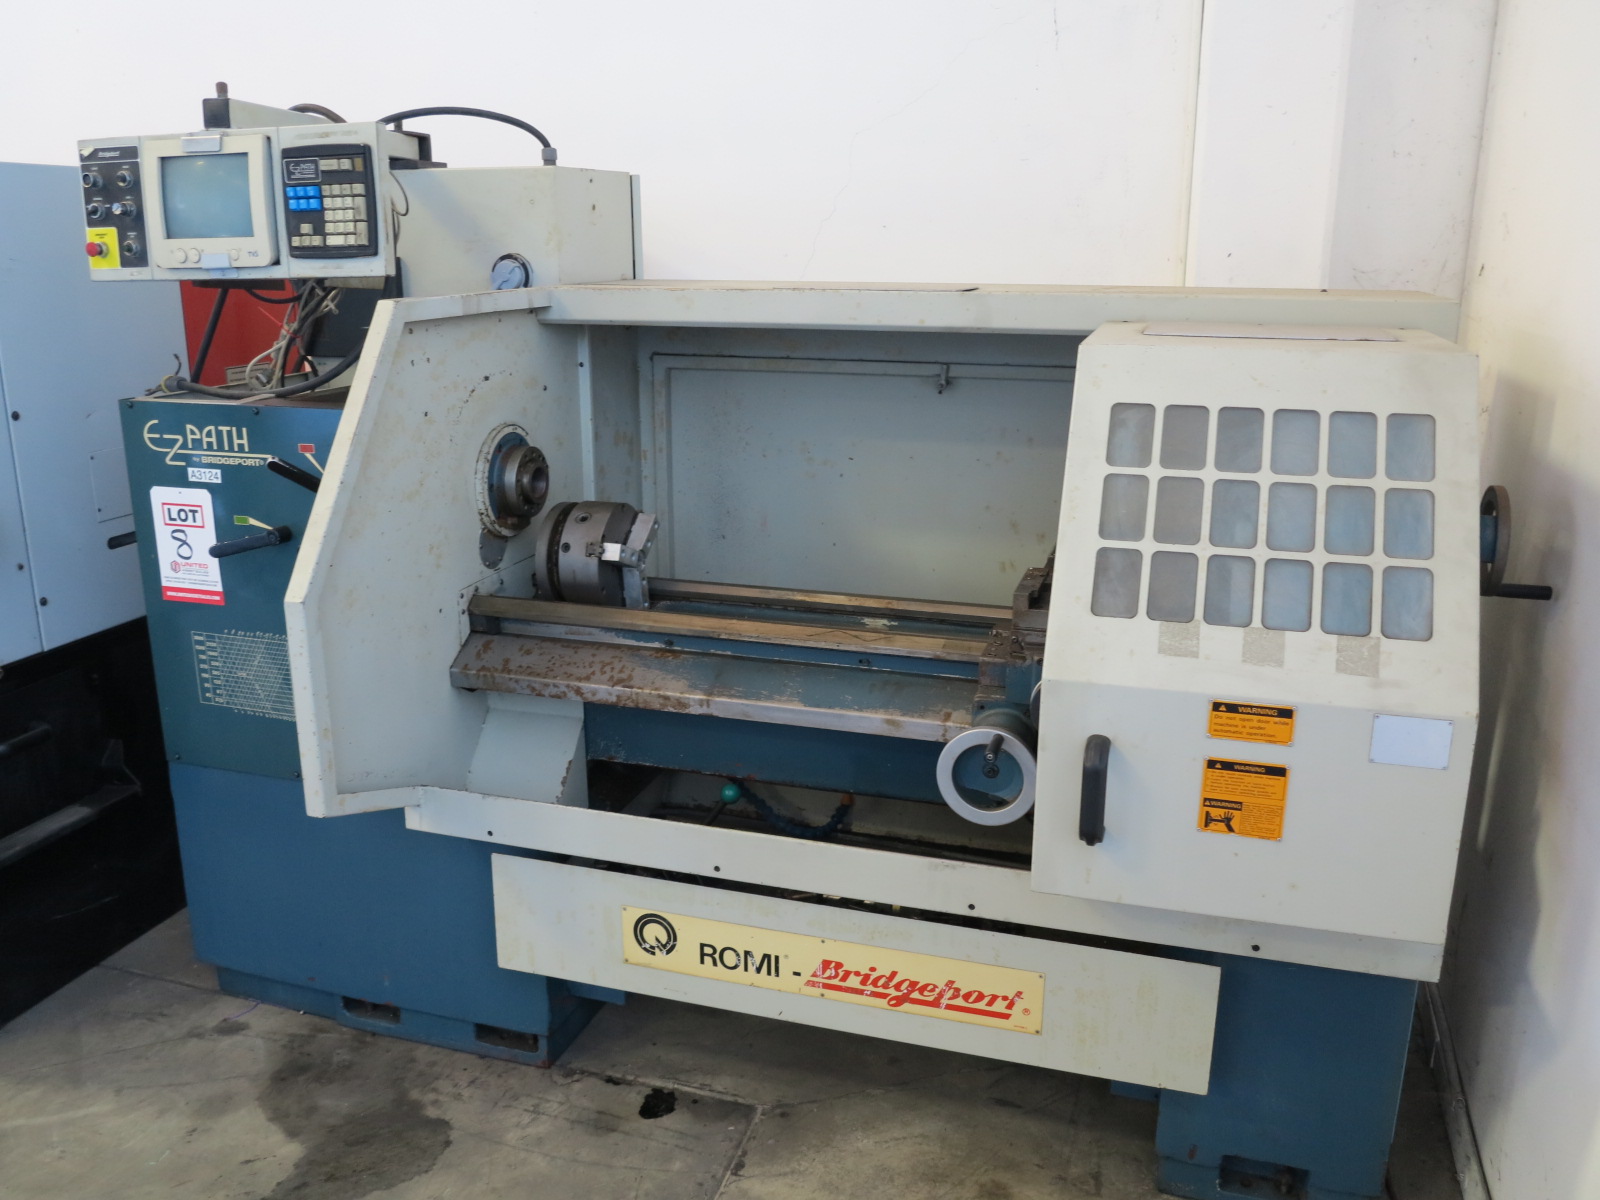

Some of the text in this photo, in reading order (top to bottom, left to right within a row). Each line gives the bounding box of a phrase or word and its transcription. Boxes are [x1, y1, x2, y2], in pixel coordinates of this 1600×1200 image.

[185, 423, 249, 452] PATH
[190, 470, 220, 481] A3124
[167, 507, 199, 524] LOT
[170, 528, 194, 561] 8
[180, 561, 209, 570] UNITED
[1237, 706, 1279, 716] WARNING
[1233, 764, 1266, 773] WARNING
[1210, 800, 1242, 810] WARNING
[699, 942, 780, 978] ROMI
[809, 958, 1025, 1011] Bridgeport
